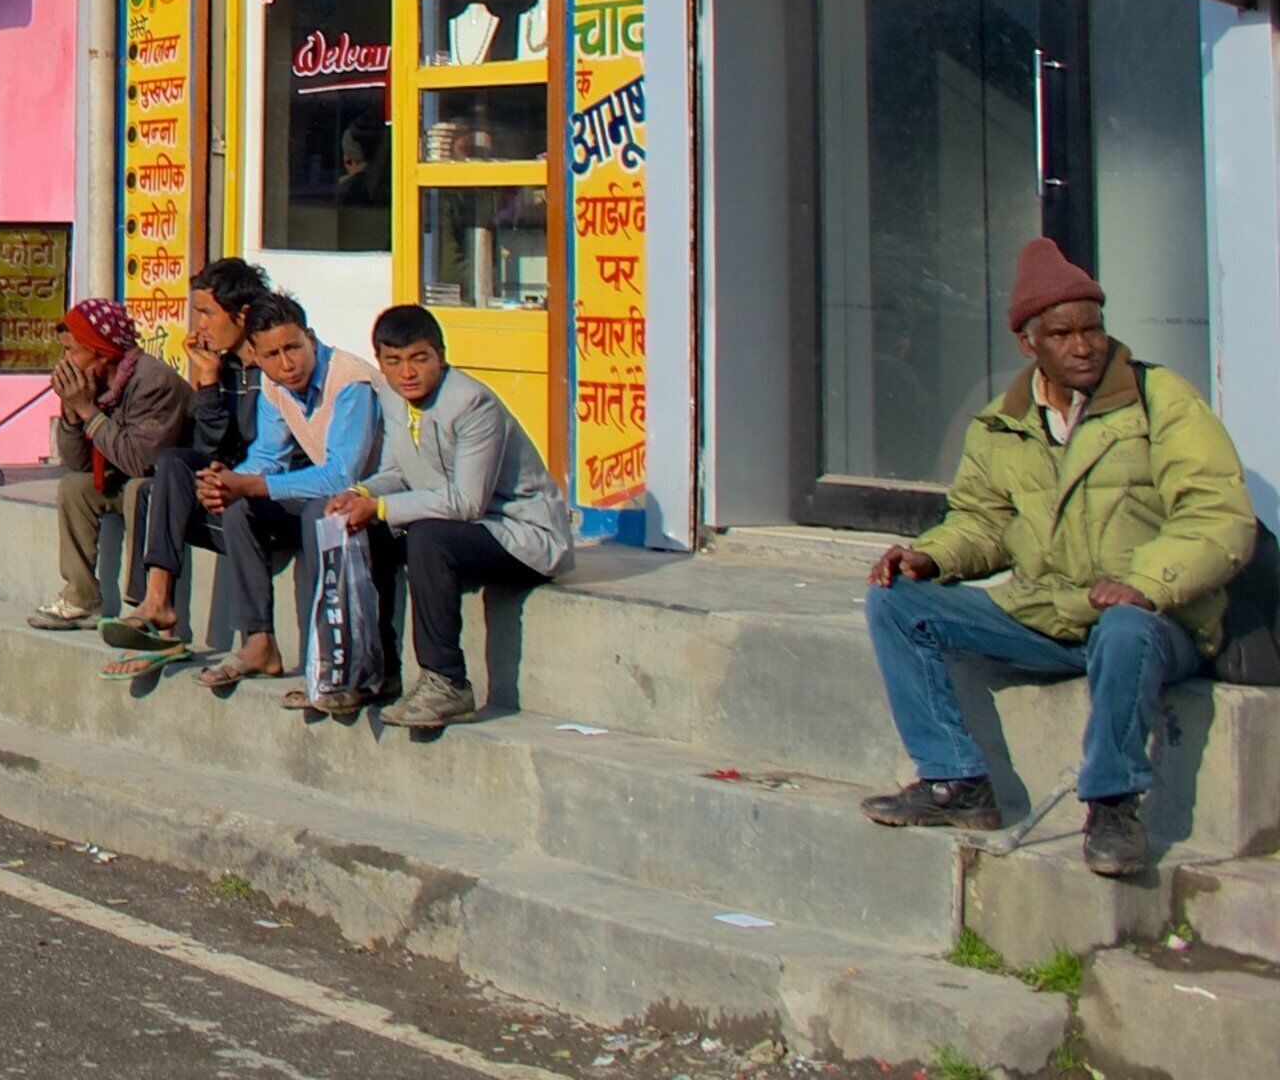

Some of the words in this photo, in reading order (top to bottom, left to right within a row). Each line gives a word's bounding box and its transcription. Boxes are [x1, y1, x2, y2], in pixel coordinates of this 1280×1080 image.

[139, 34, 182, 65] नीलम
[139, 77, 186, 108] पुखराज
[139, 118, 178, 147] पन्ना
[140, 154, 186, 194] माणिक
[141, 200, 177, 240] मोती
[596, 255, 642, 296] पर
